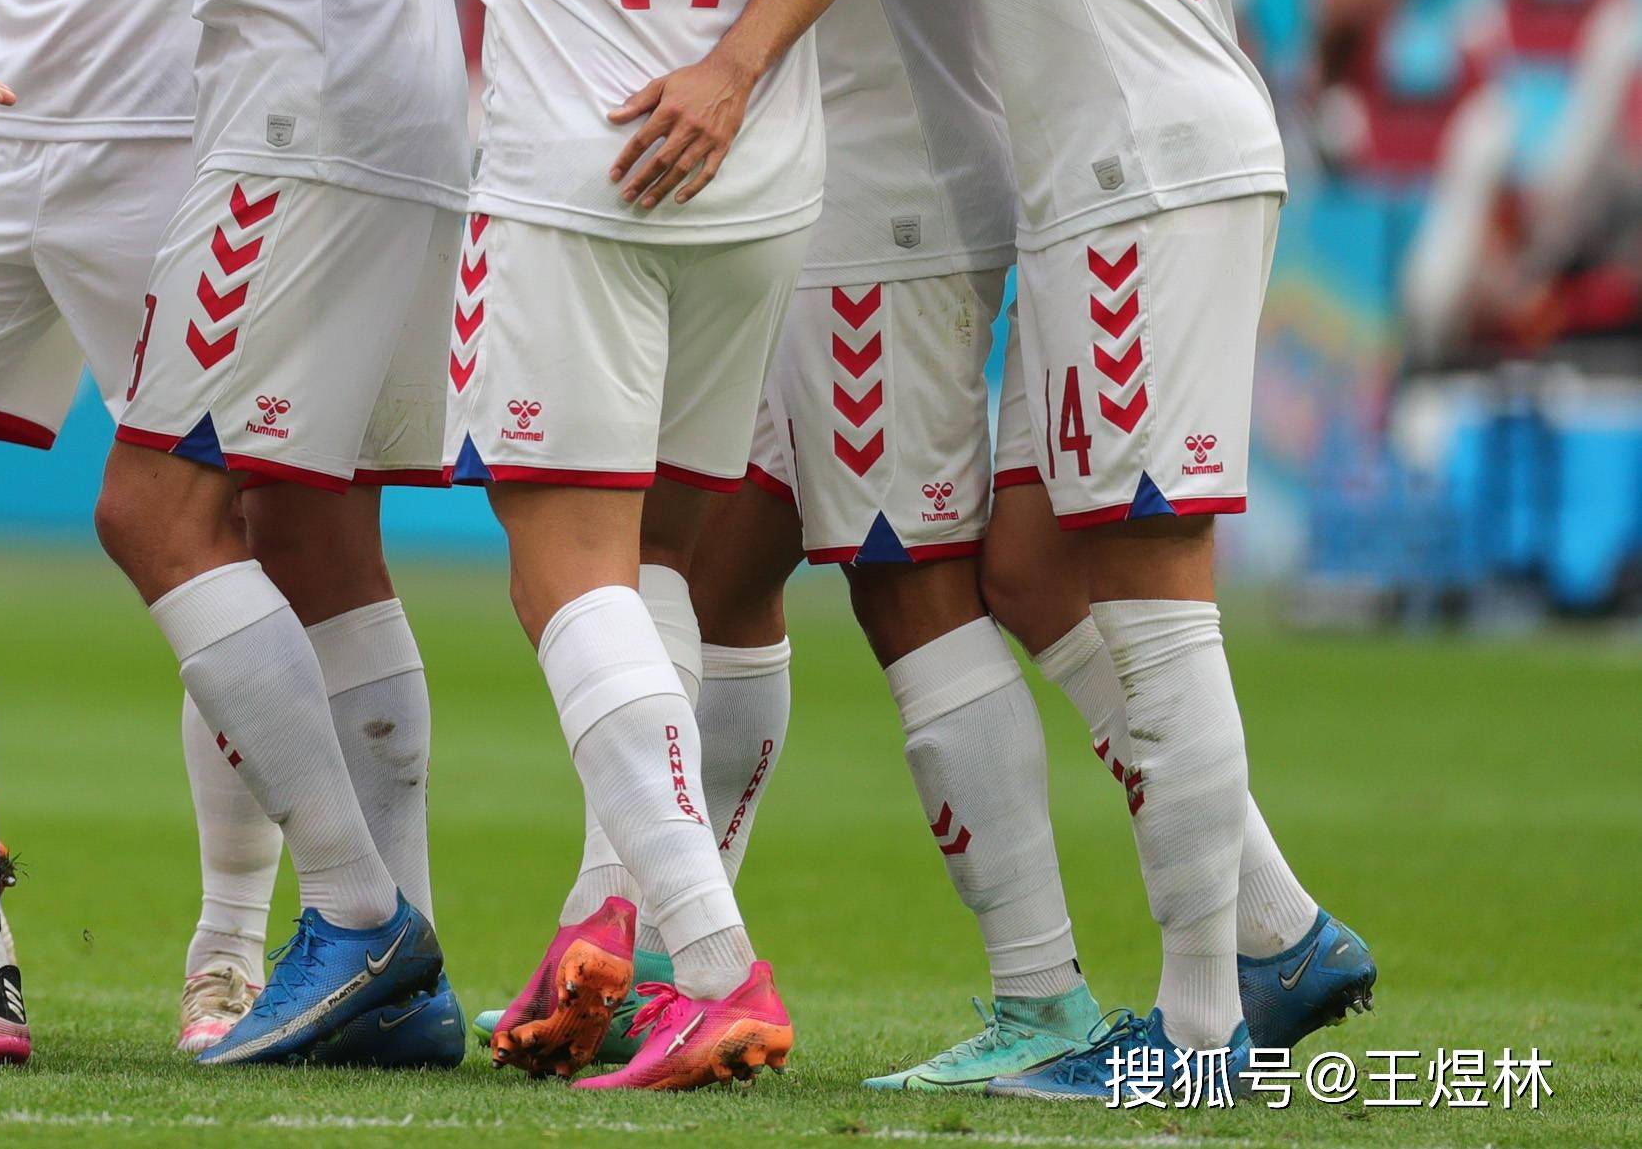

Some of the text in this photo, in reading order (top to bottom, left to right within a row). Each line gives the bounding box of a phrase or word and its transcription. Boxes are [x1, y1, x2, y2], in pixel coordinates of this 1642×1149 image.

[246, 420, 289, 439] hummel
[1045, 366, 1092, 479] 14
[501, 428, 544, 442] hummel
[1182, 462, 1224, 475] hummel
[921, 509, 959, 522] hummel
[718, 739, 774, 851] DANMARK
